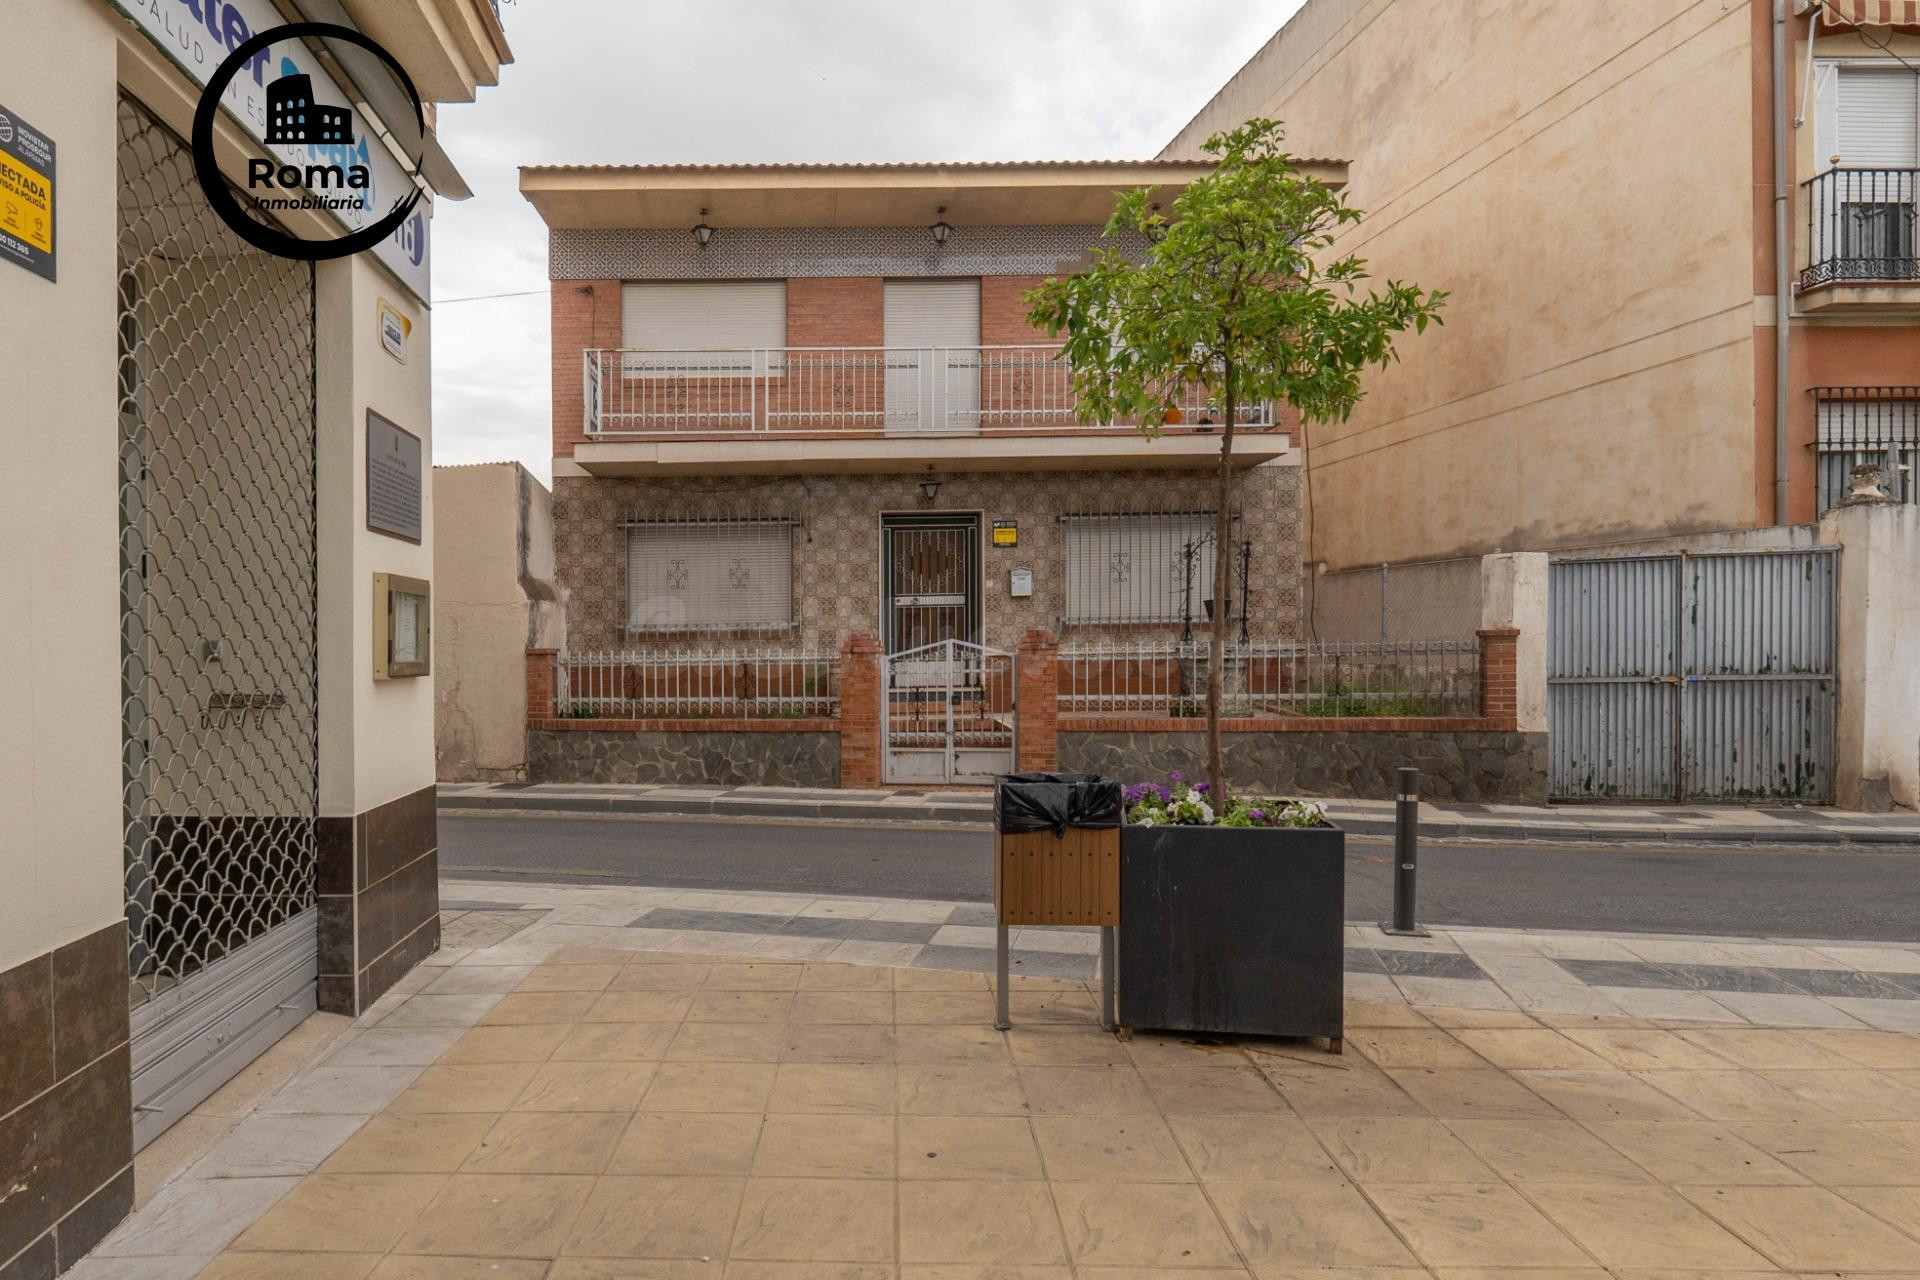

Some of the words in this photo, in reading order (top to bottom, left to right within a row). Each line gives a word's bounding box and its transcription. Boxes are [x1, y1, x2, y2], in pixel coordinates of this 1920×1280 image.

[17, 125, 49, 153] MOVISTAR
[17, 135, 52, 164] PROSEGUR
[0, 163, 46, 201] ECTADA
